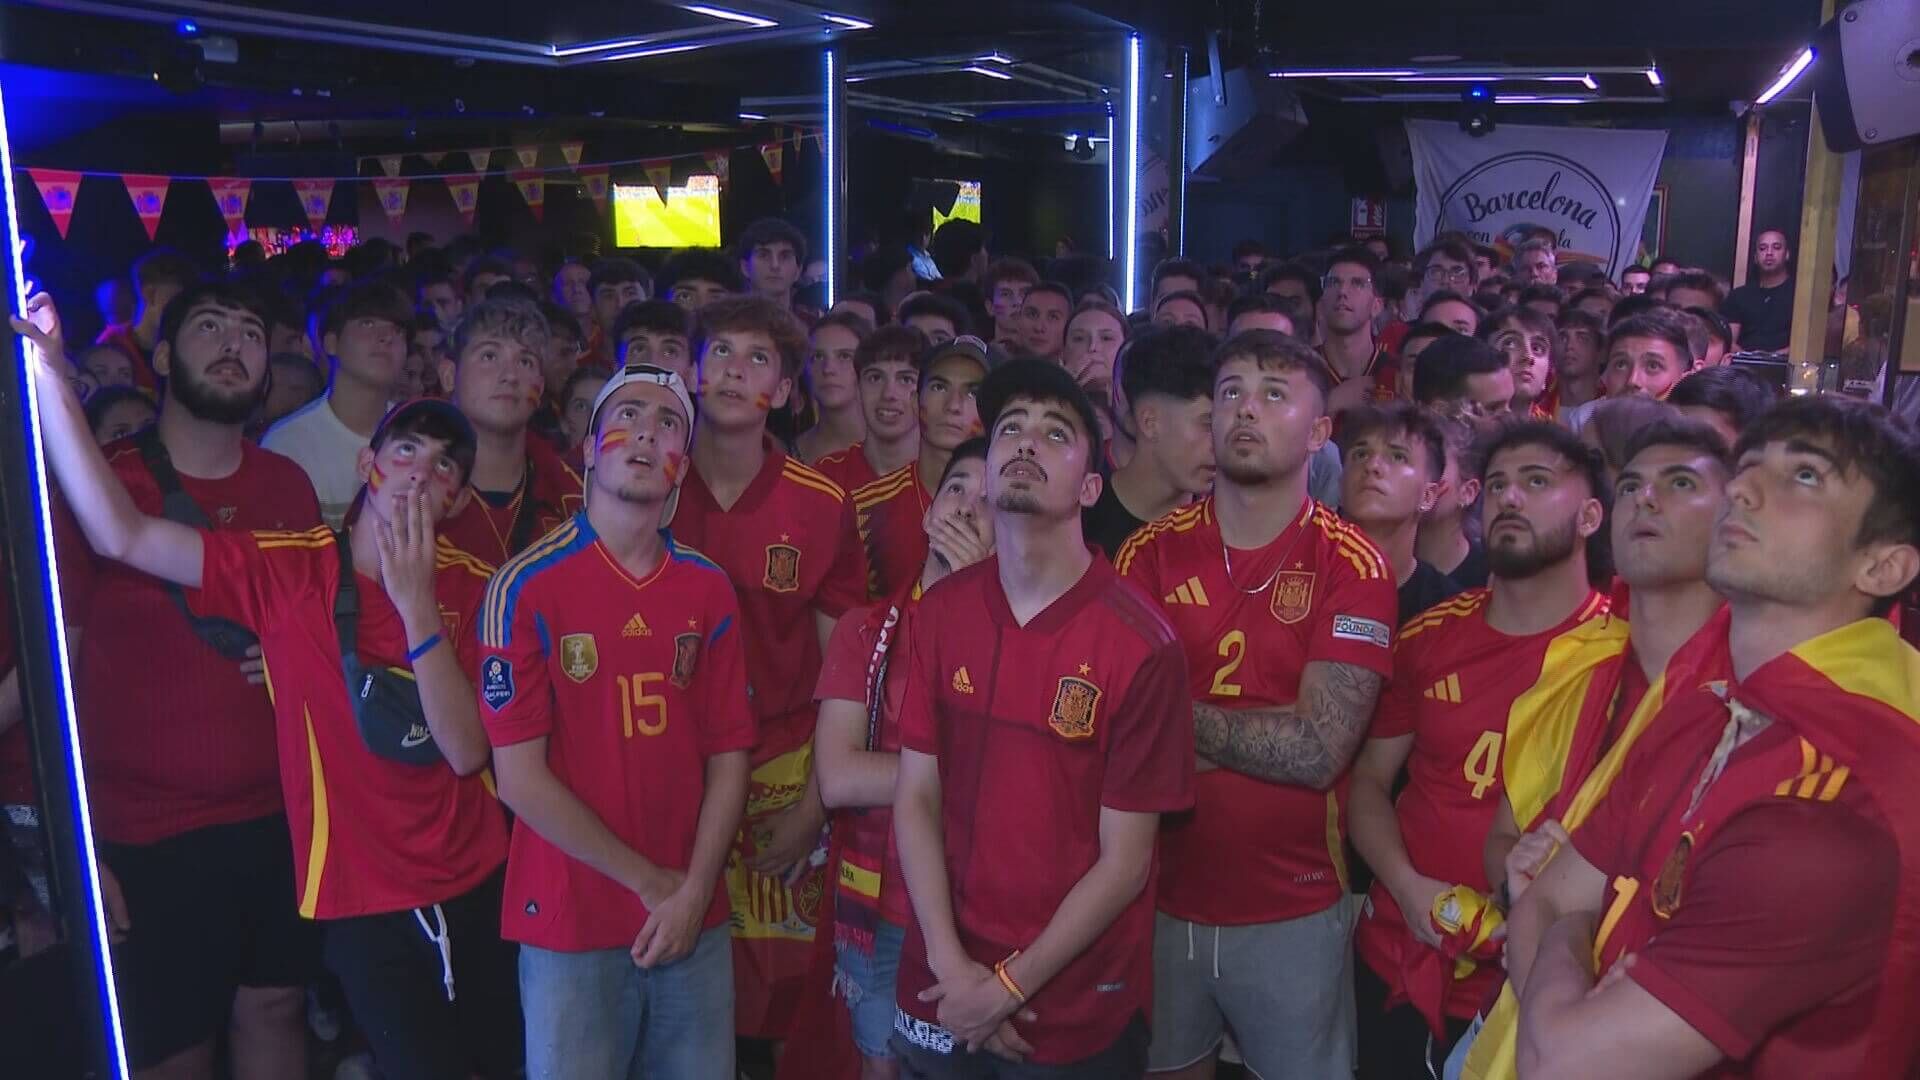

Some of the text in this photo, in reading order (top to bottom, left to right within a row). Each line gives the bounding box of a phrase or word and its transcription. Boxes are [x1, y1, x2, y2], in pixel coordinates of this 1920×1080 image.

[1462, 171, 1597, 229] Barcelona
[1209, 630, 1246, 696] 2
[617, 672, 667, 738] 15
[1464, 730, 1503, 800] 4
